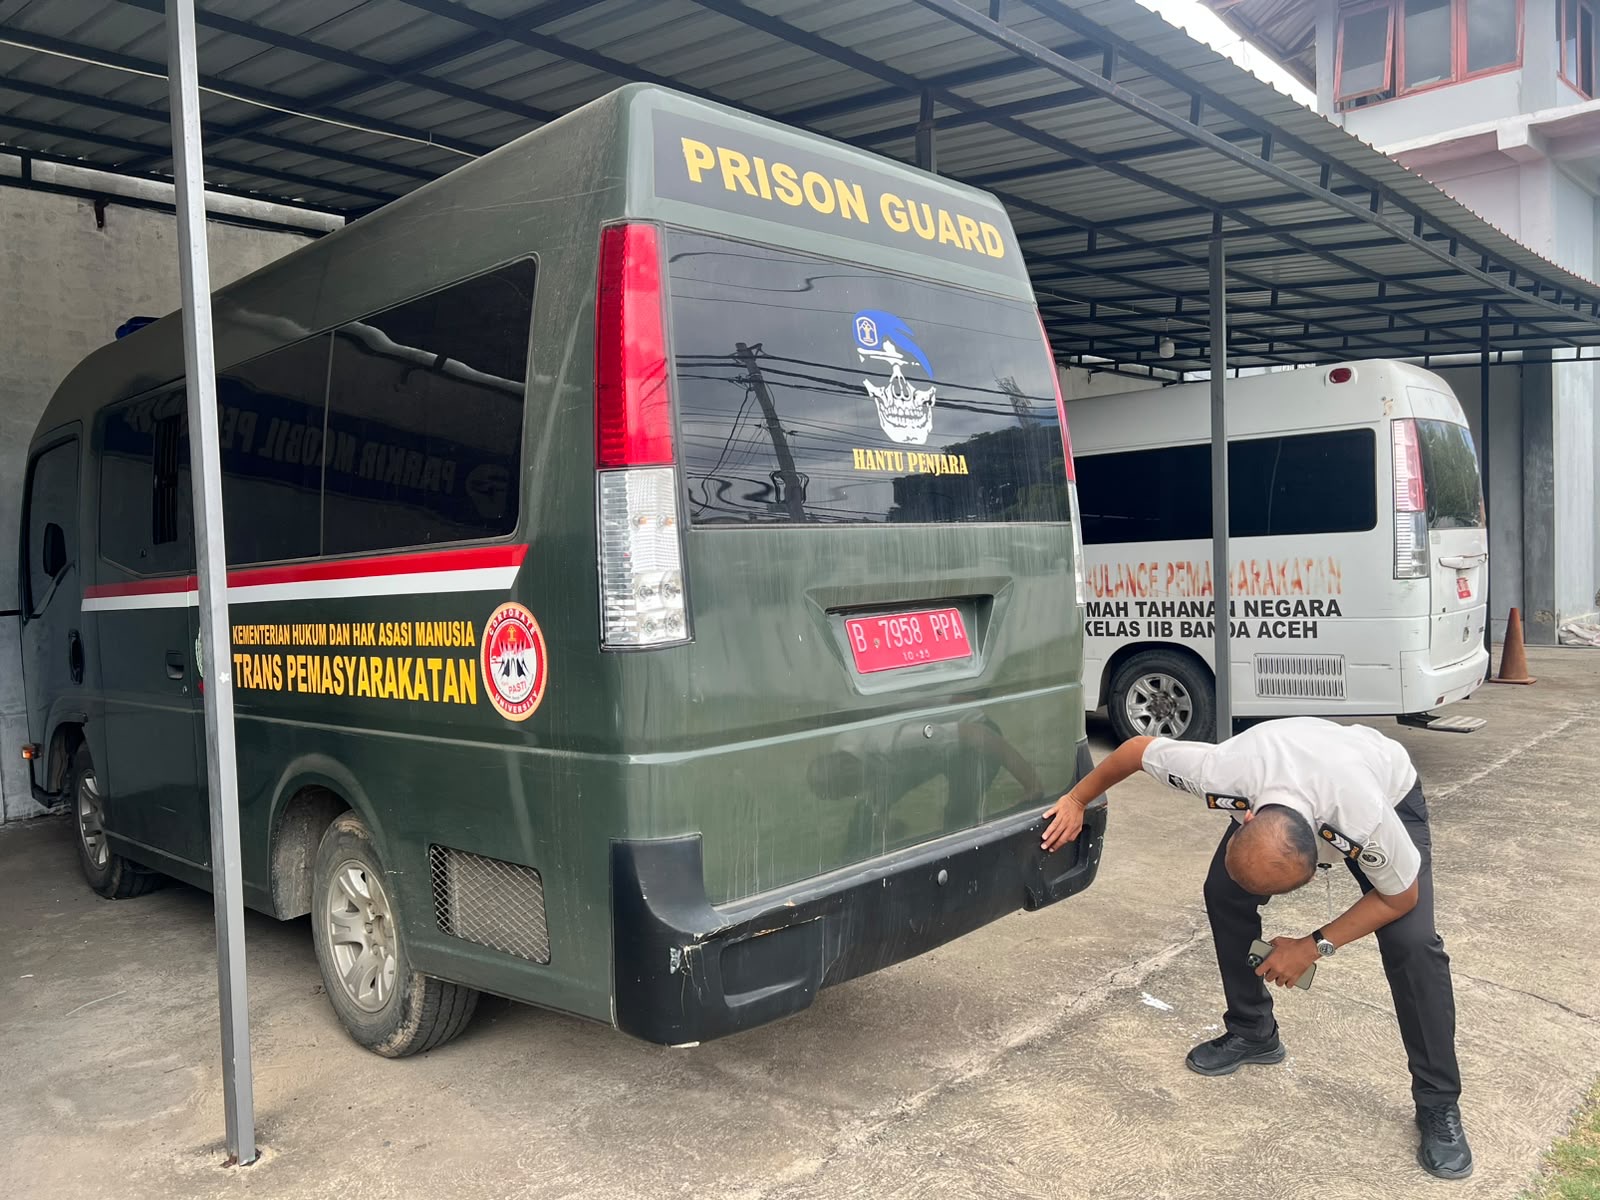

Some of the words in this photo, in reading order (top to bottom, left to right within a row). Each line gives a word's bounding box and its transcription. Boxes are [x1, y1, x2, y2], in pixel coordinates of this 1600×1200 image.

[680, 136, 870, 224] PRISON
[879, 192, 1005, 259] GUARD
[852, 448, 904, 472] HANTU
[906, 451, 969, 477] PENJARA
[489, 608, 536, 636] CORPORATE
[1244, 599, 1342, 618] NEGARA
[232, 624, 290, 646] KEMENTERIAN
[292, 623, 327, 646] HUKUM
[329, 623, 350, 646] DAN
[352, 622, 376, 646] HAK
[378, 622, 412, 647] ASASI
[415, 621, 475, 647] MANUSIA
[852, 623, 867, 652] B
[878, 617, 923, 648] 7958
[929, 612, 963, 641] PPA
[1147, 621, 1173, 638] IIB
[1257, 620, 1318, 639] ACEH
[233, 653, 283, 692] TRANS
[286, 655, 477, 705] PEMASYARAKATAN
[494, 690, 538, 714] UNIVERSITY
